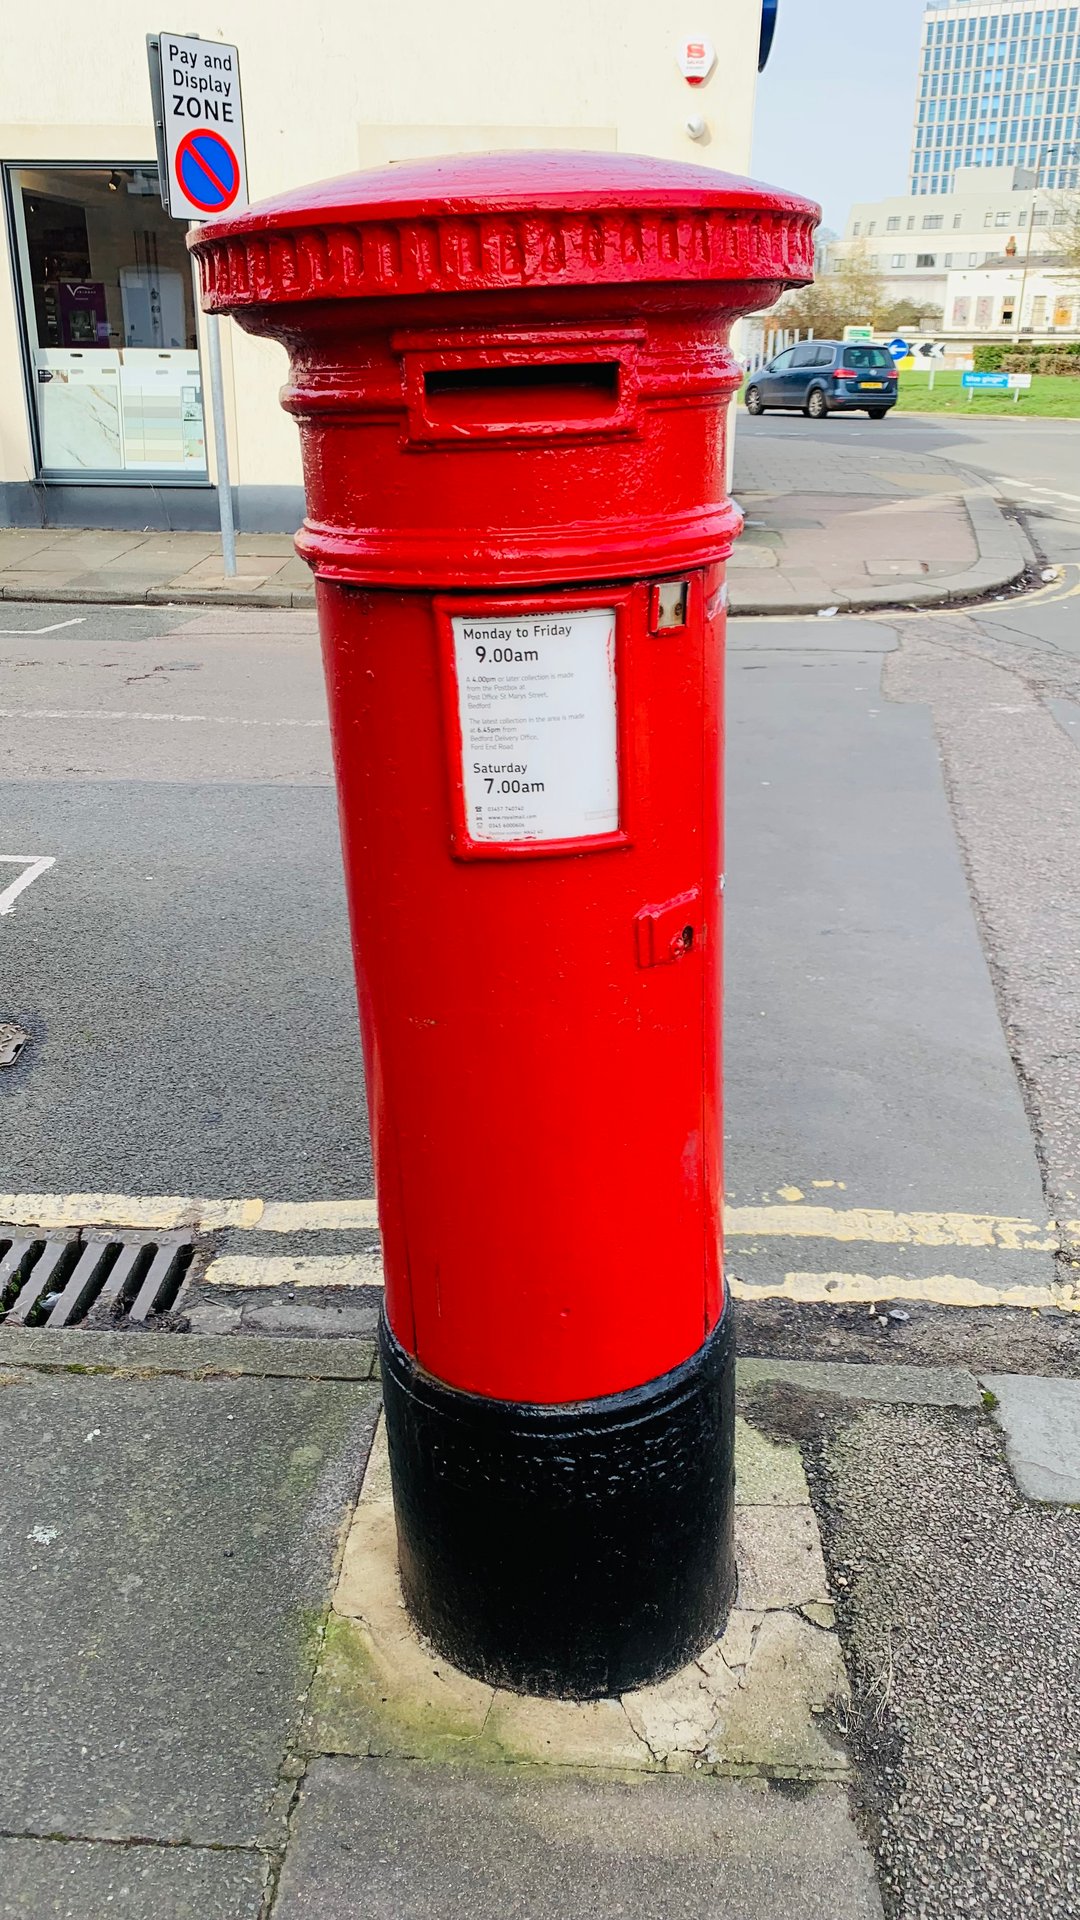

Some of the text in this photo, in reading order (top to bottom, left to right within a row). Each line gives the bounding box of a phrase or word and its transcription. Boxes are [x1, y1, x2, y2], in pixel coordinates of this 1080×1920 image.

[169, 44, 232, 71] Pay and
[173, 68, 231, 97] Display
[172, 94, 234, 123] ZONE
[463, 625, 572, 641] Monday to Friday
[475, 646, 539, 663] 9.00am
[472, 675, 496, 684] 4.00pm
[477, 726, 501, 734] 6.45pm
[494, 734, 519, 743] Delivery
[473, 762, 527, 775] Saturday
[484, 778, 545, 794] 7.00am
